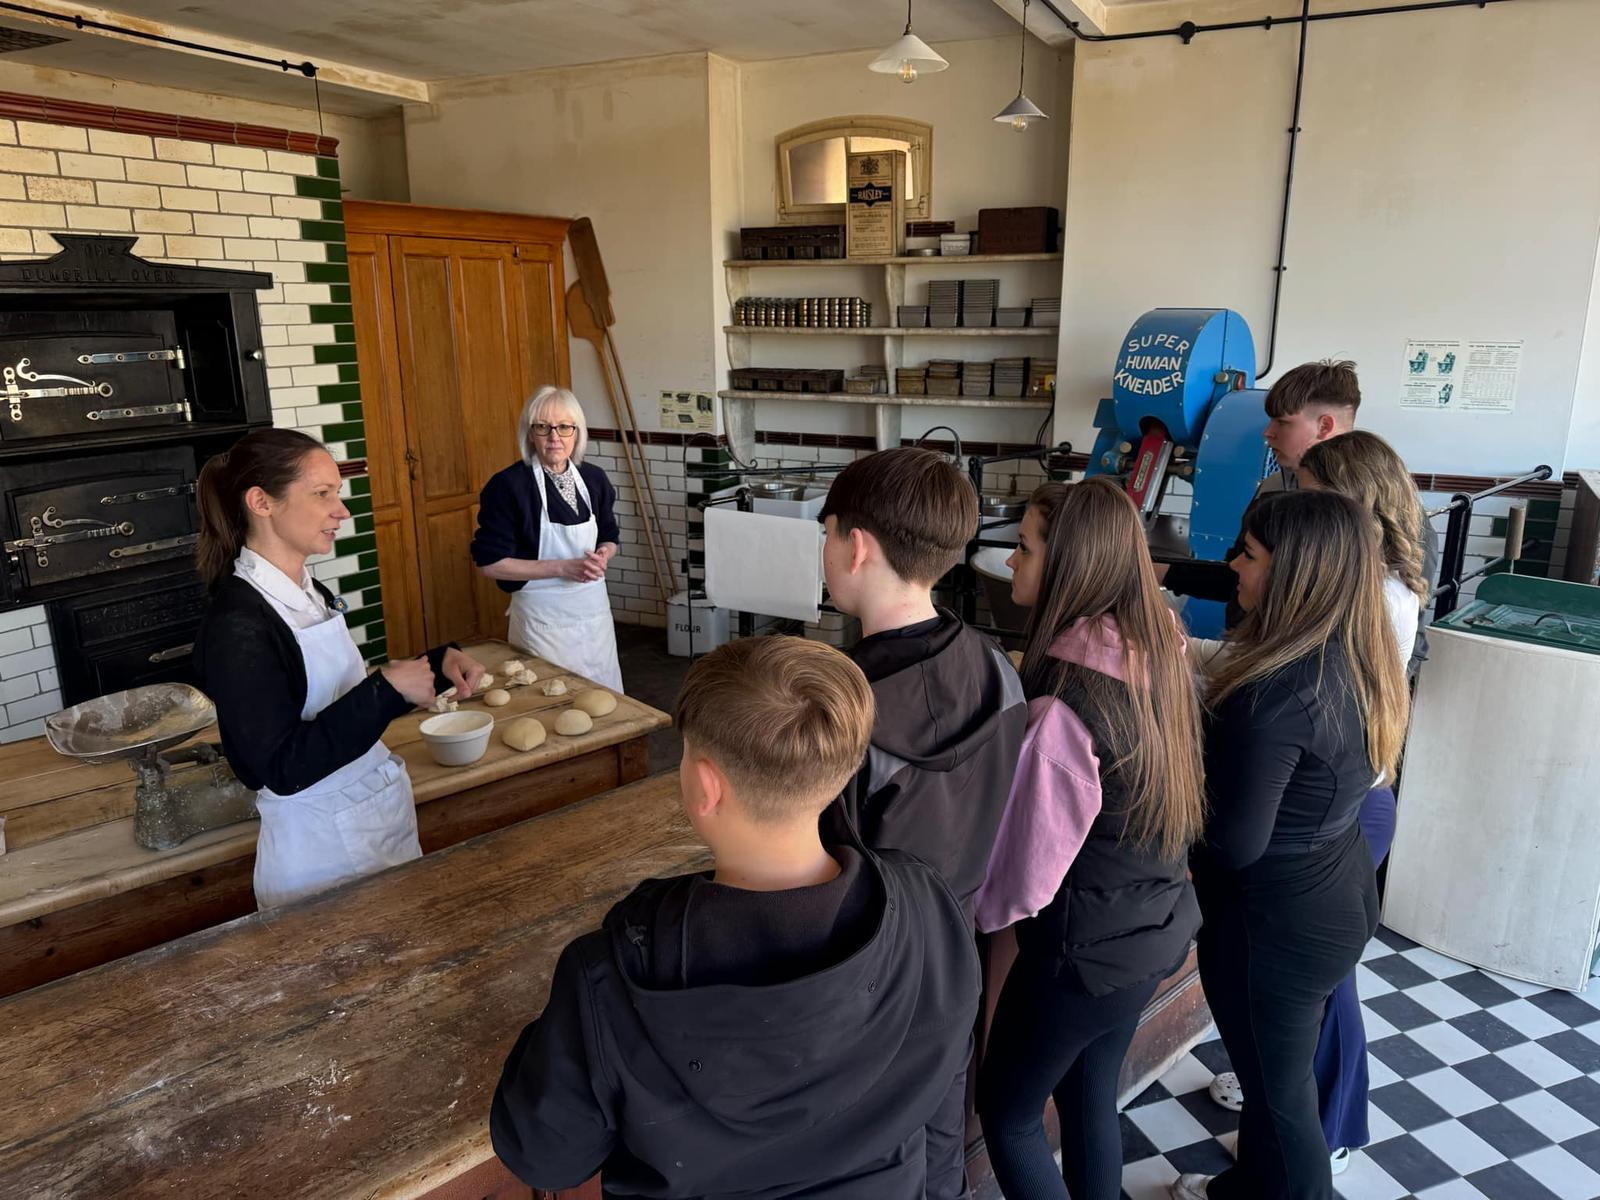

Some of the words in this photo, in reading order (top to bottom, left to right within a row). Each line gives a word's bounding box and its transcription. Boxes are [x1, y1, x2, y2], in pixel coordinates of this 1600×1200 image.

[131, 269, 176, 282] OVEN
[1127, 333, 1190, 355] SUPER
[1125, 355, 1182, 371] HUMAN
[1114, 368, 1185, 396] KNEADER
[675, 624, 701, 633] FLOUR
